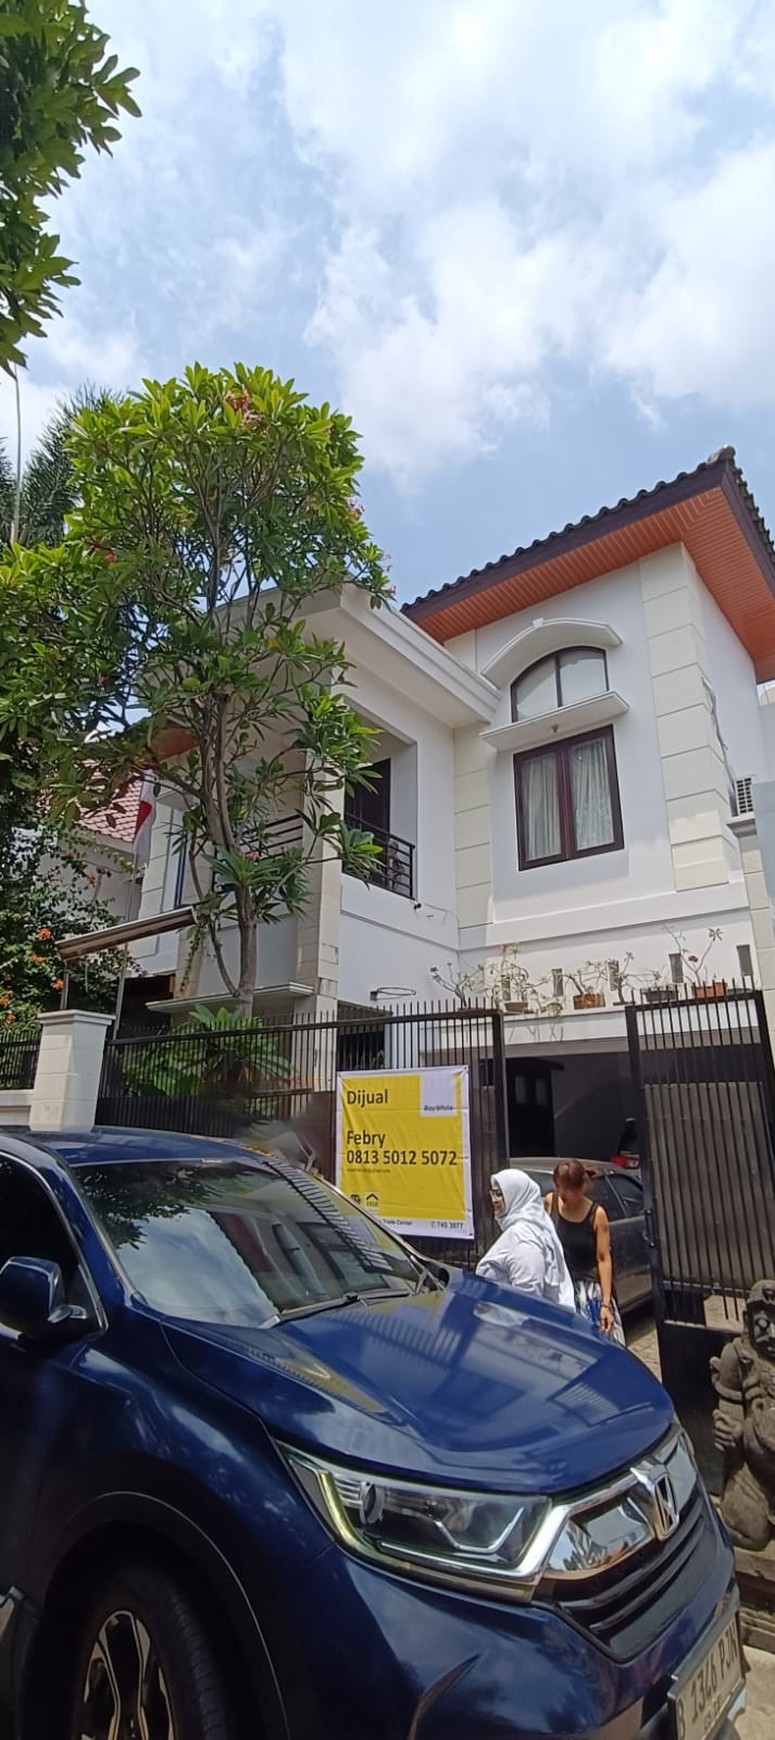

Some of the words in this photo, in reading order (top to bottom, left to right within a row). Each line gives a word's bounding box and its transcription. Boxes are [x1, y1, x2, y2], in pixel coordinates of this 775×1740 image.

[347, 1089, 388, 1108] Dijual
[347, 1130, 386, 1149] Febry
[346, 1150, 379, 1165] 0813
[383, 1150, 417, 1166] 5012
[421, 1150, 458, 1166] 5072
